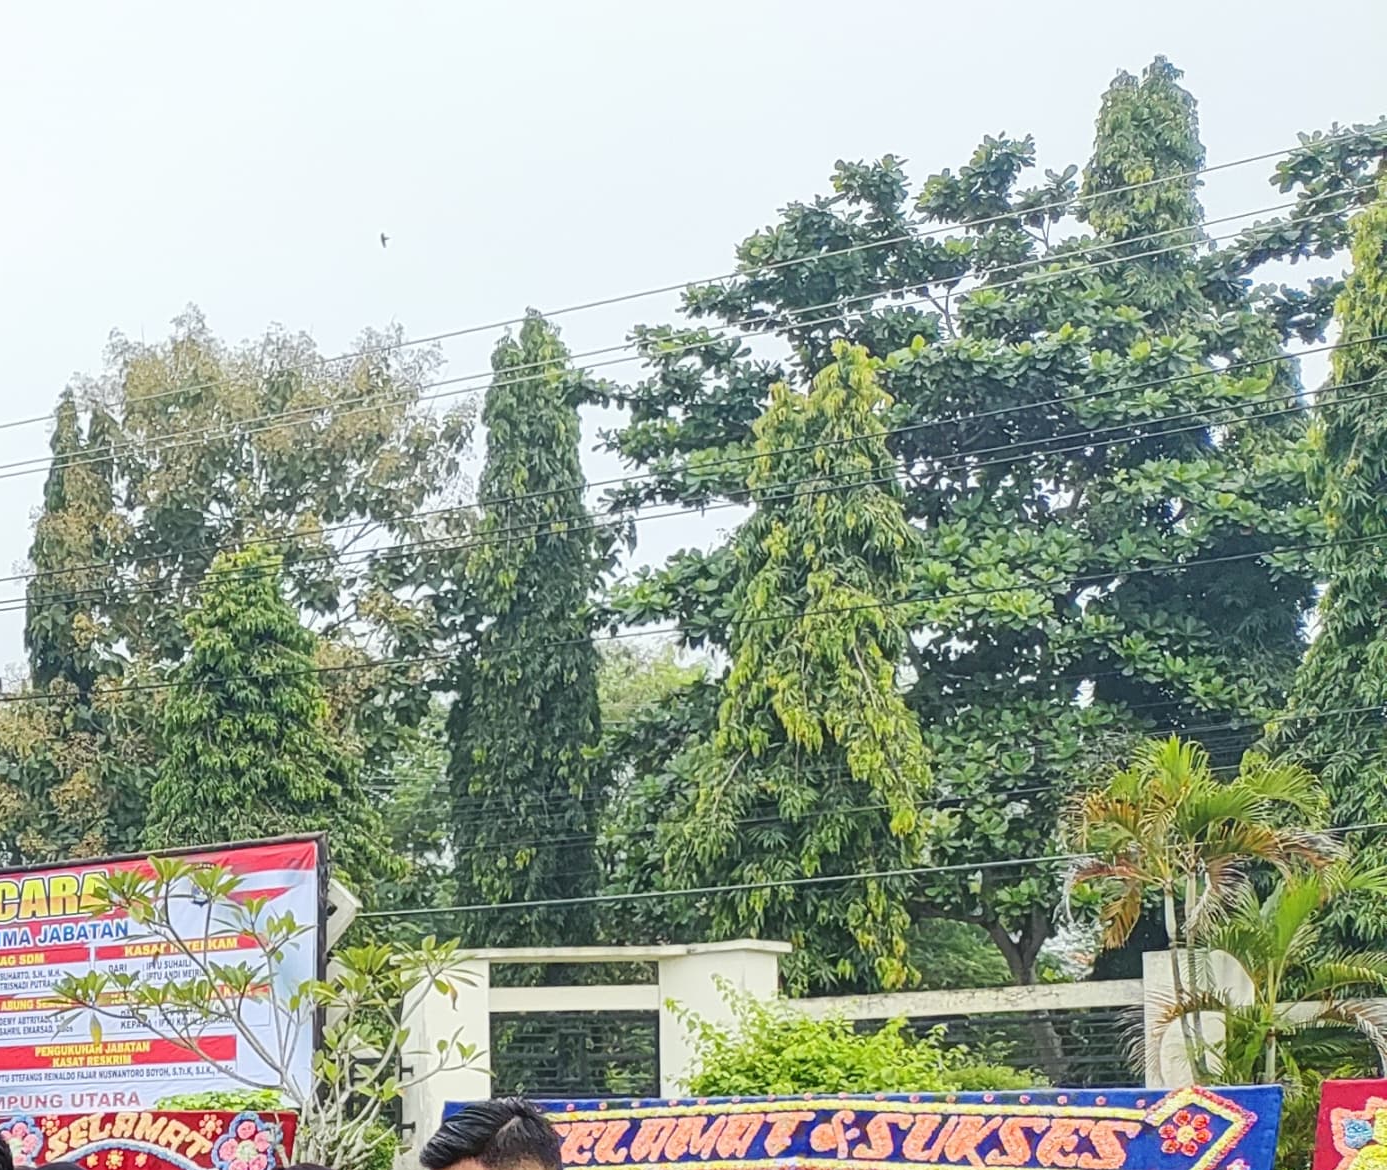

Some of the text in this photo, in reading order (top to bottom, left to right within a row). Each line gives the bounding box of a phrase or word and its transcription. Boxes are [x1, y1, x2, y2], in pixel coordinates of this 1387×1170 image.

[38, 921, 128, 944] JABATAN
[18, 953, 45, 965] SDM
[1, 999, 34, 1012] ABUNG
[105, 1040, 151, 1053] JABATAN
[52, 1054, 132, 1068] KASAT RESKRIM
[44, 1070, 75, 1081] REINALDO
[77, 1069, 97, 1080] FAJAR
[70, 1091, 141, 1109] UTARA
[45, 1111, 215, 1162] SELAMAT
[553, 1110, 816, 1164] ELAMAT
